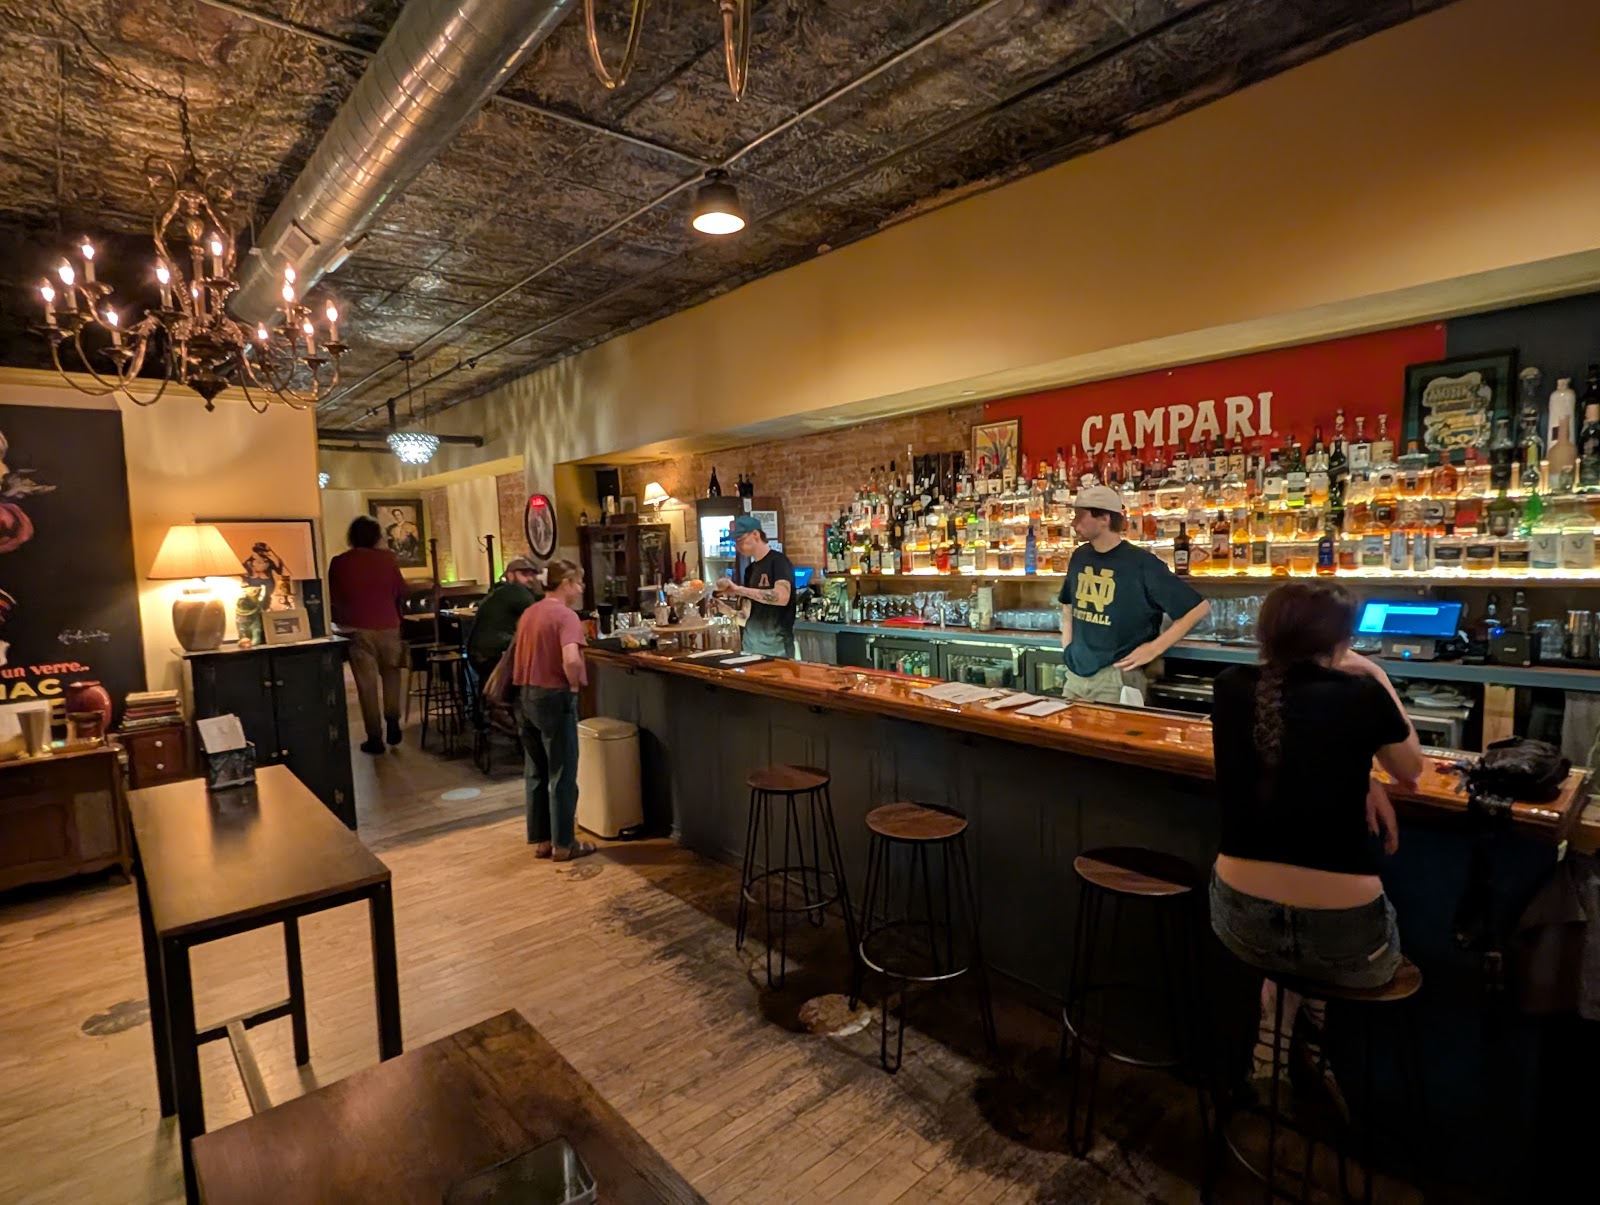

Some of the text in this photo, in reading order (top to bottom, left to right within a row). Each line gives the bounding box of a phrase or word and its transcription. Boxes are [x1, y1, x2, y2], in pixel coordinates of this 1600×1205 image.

[1081, 391, 1274, 456] CAMPARI
[1073, 608, 1112, 626] TBALL
[1, 667, 26, 678] un
